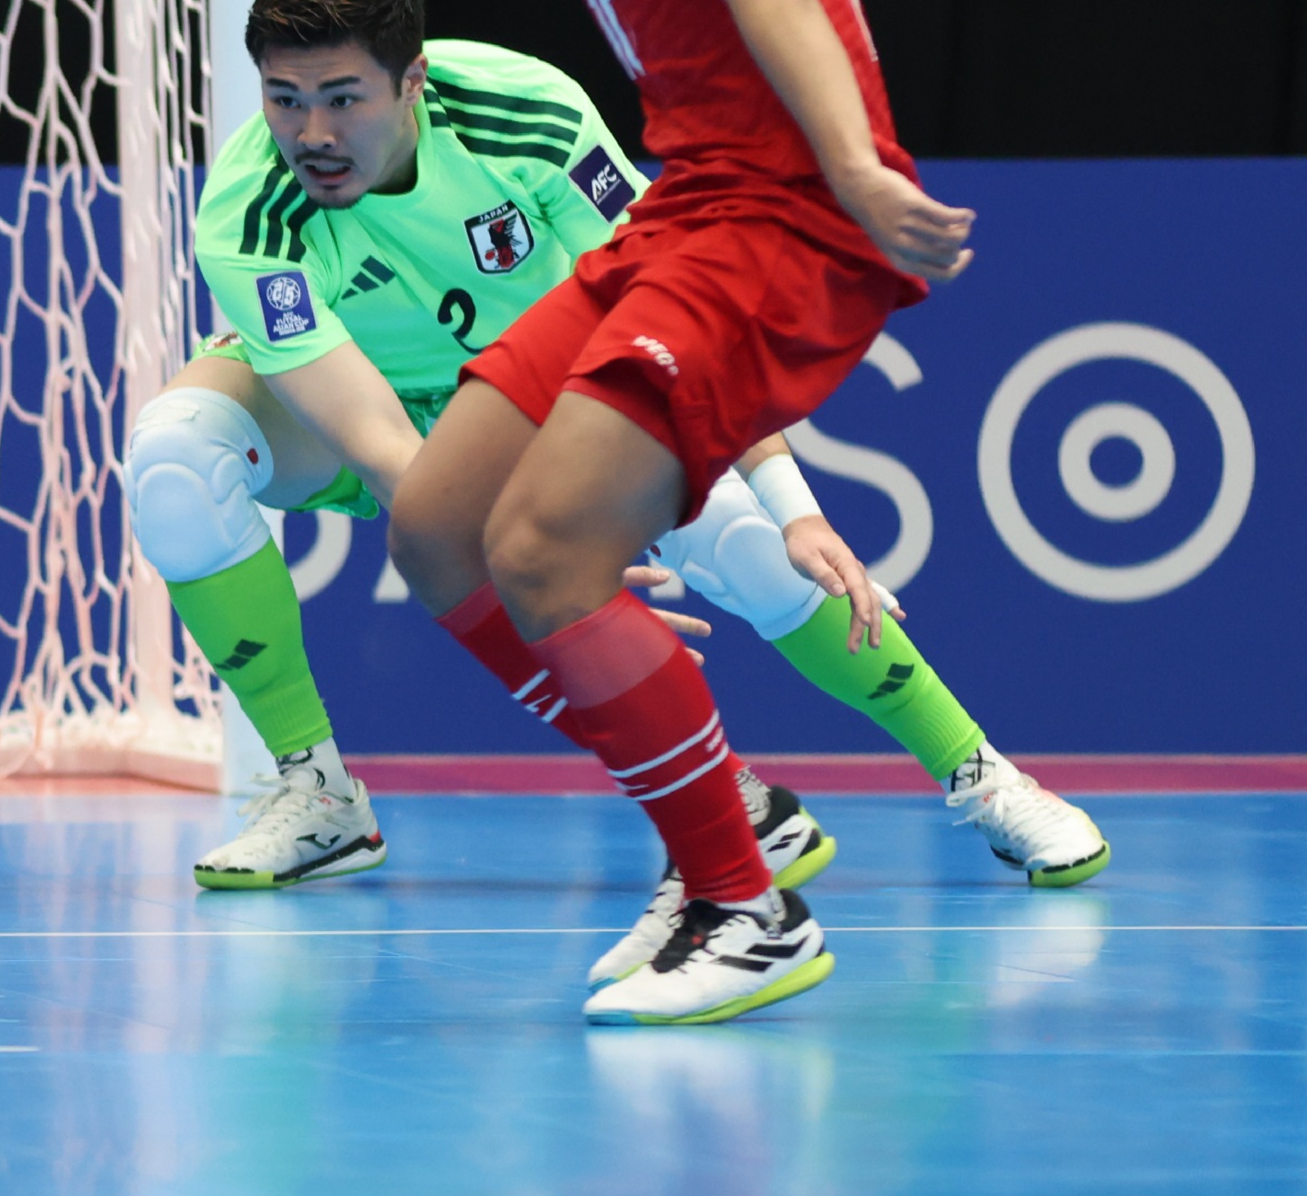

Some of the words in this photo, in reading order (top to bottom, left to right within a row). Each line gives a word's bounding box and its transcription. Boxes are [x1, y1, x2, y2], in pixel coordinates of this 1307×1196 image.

[591, 164, 617, 202] AFC
[478, 205, 508, 223] JAPAN
[438, 288, 484, 355] 2
